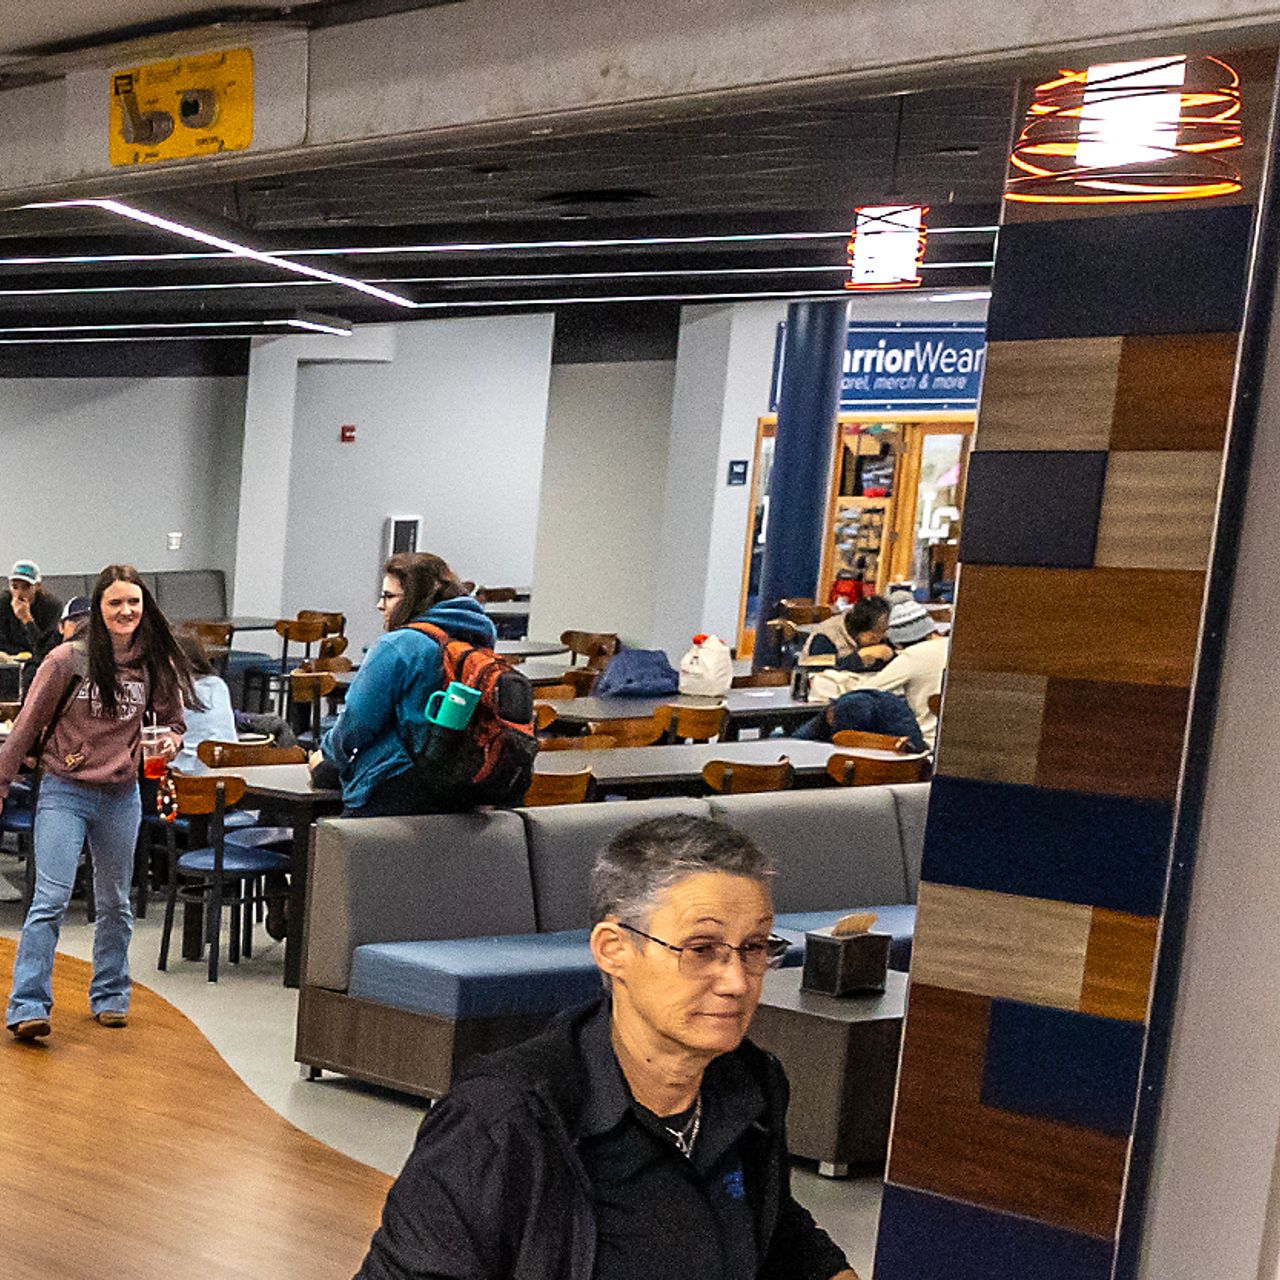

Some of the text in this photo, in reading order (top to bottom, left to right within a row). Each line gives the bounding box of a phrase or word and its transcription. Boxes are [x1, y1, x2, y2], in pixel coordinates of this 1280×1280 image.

[873, 374, 915, 390] merch
[918, 374, 929, 390] &
[931, 376, 966, 390] more
